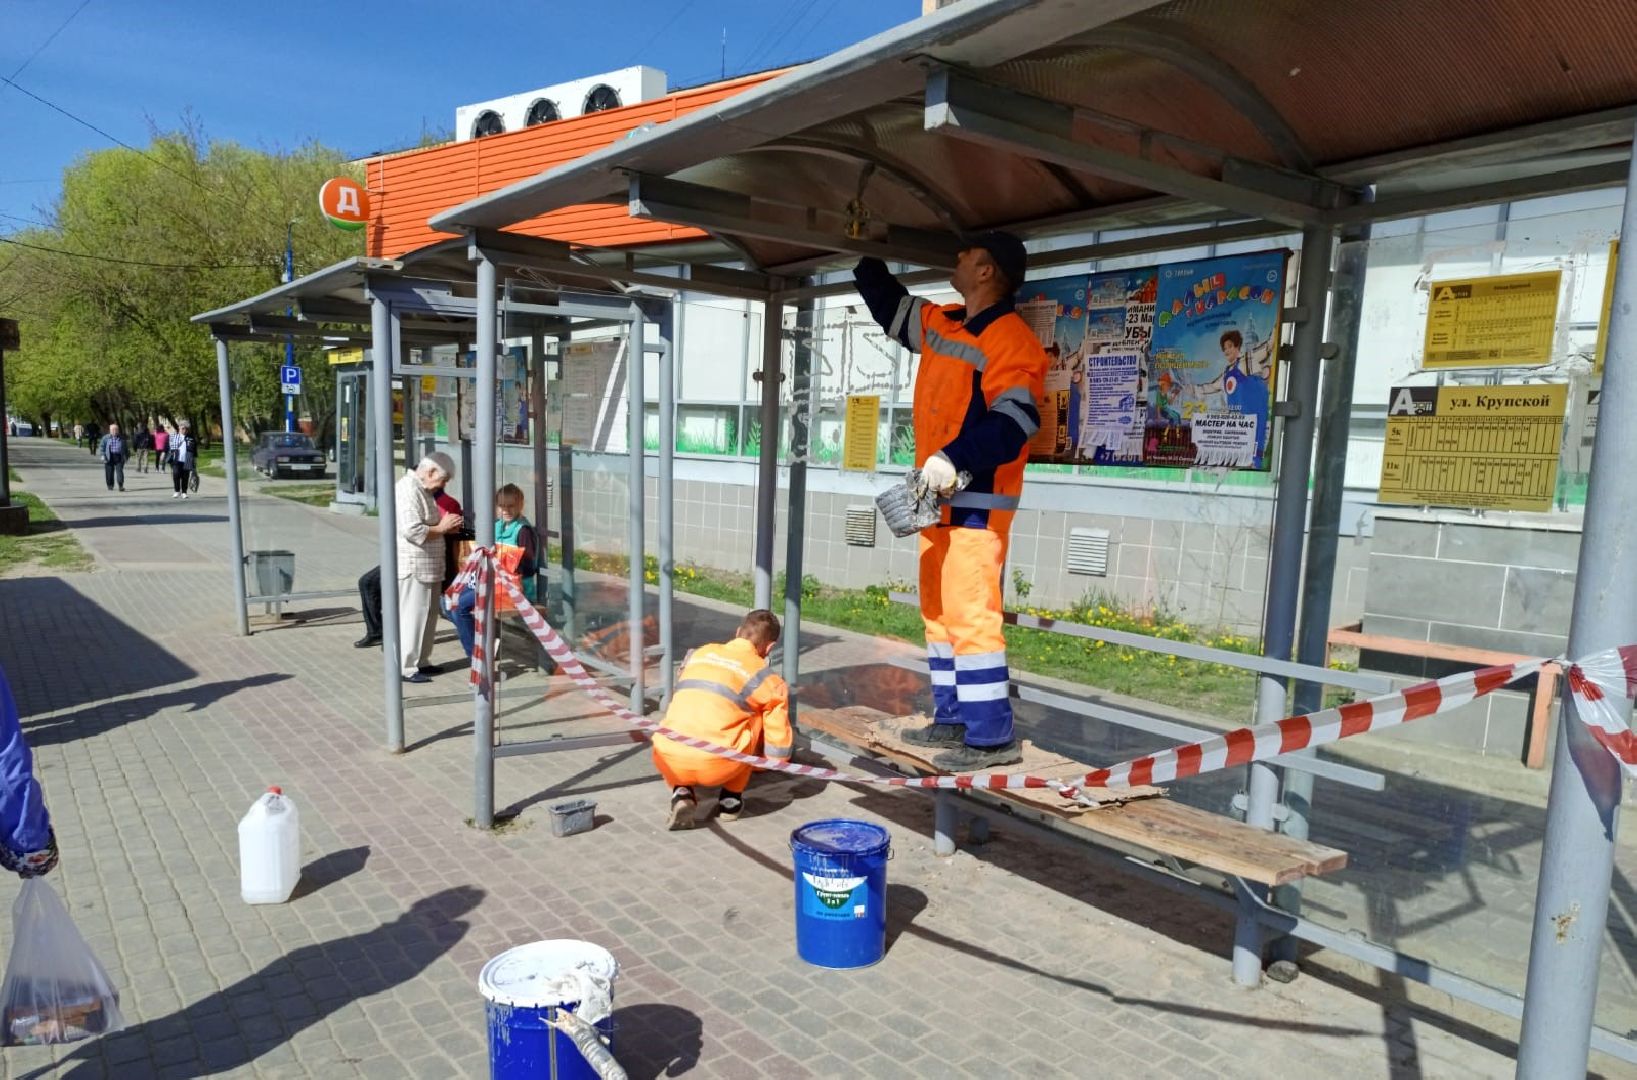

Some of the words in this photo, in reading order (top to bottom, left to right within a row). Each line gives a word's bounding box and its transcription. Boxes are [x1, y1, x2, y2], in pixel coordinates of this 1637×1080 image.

[336, 185, 361, 217] Д
[285, 368, 297, 383] P
[1450, 398, 1472, 411] ул.
[1476, 394, 1551, 411] Крупской
[1195, 419, 1226, 428] МАСТЕР
[1226, 420, 1237, 428] НА
[1238, 420, 1255, 429] ЧАС
